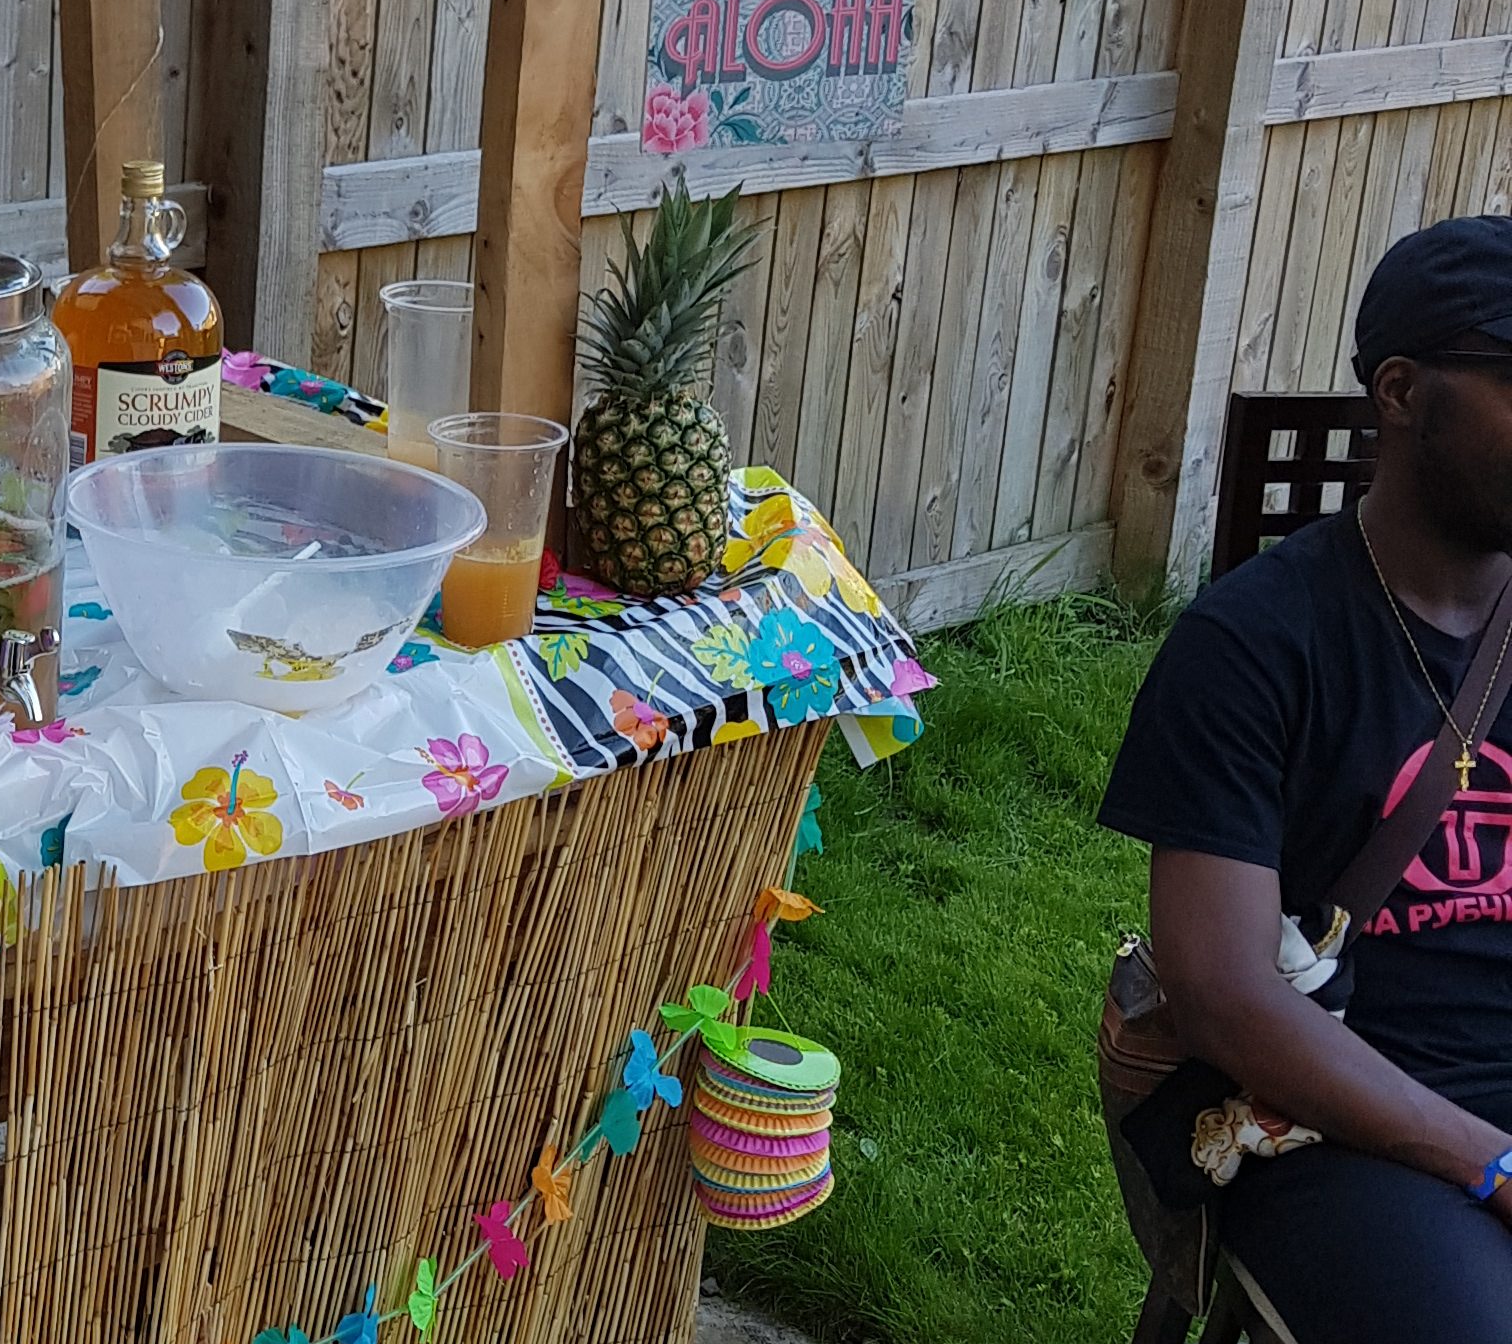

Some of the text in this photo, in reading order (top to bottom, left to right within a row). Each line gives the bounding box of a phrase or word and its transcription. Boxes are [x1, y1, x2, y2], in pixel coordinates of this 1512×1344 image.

[118, 384, 215, 413] SCRUMPY
[117, 405, 214, 426] CLOUDY CIDER
